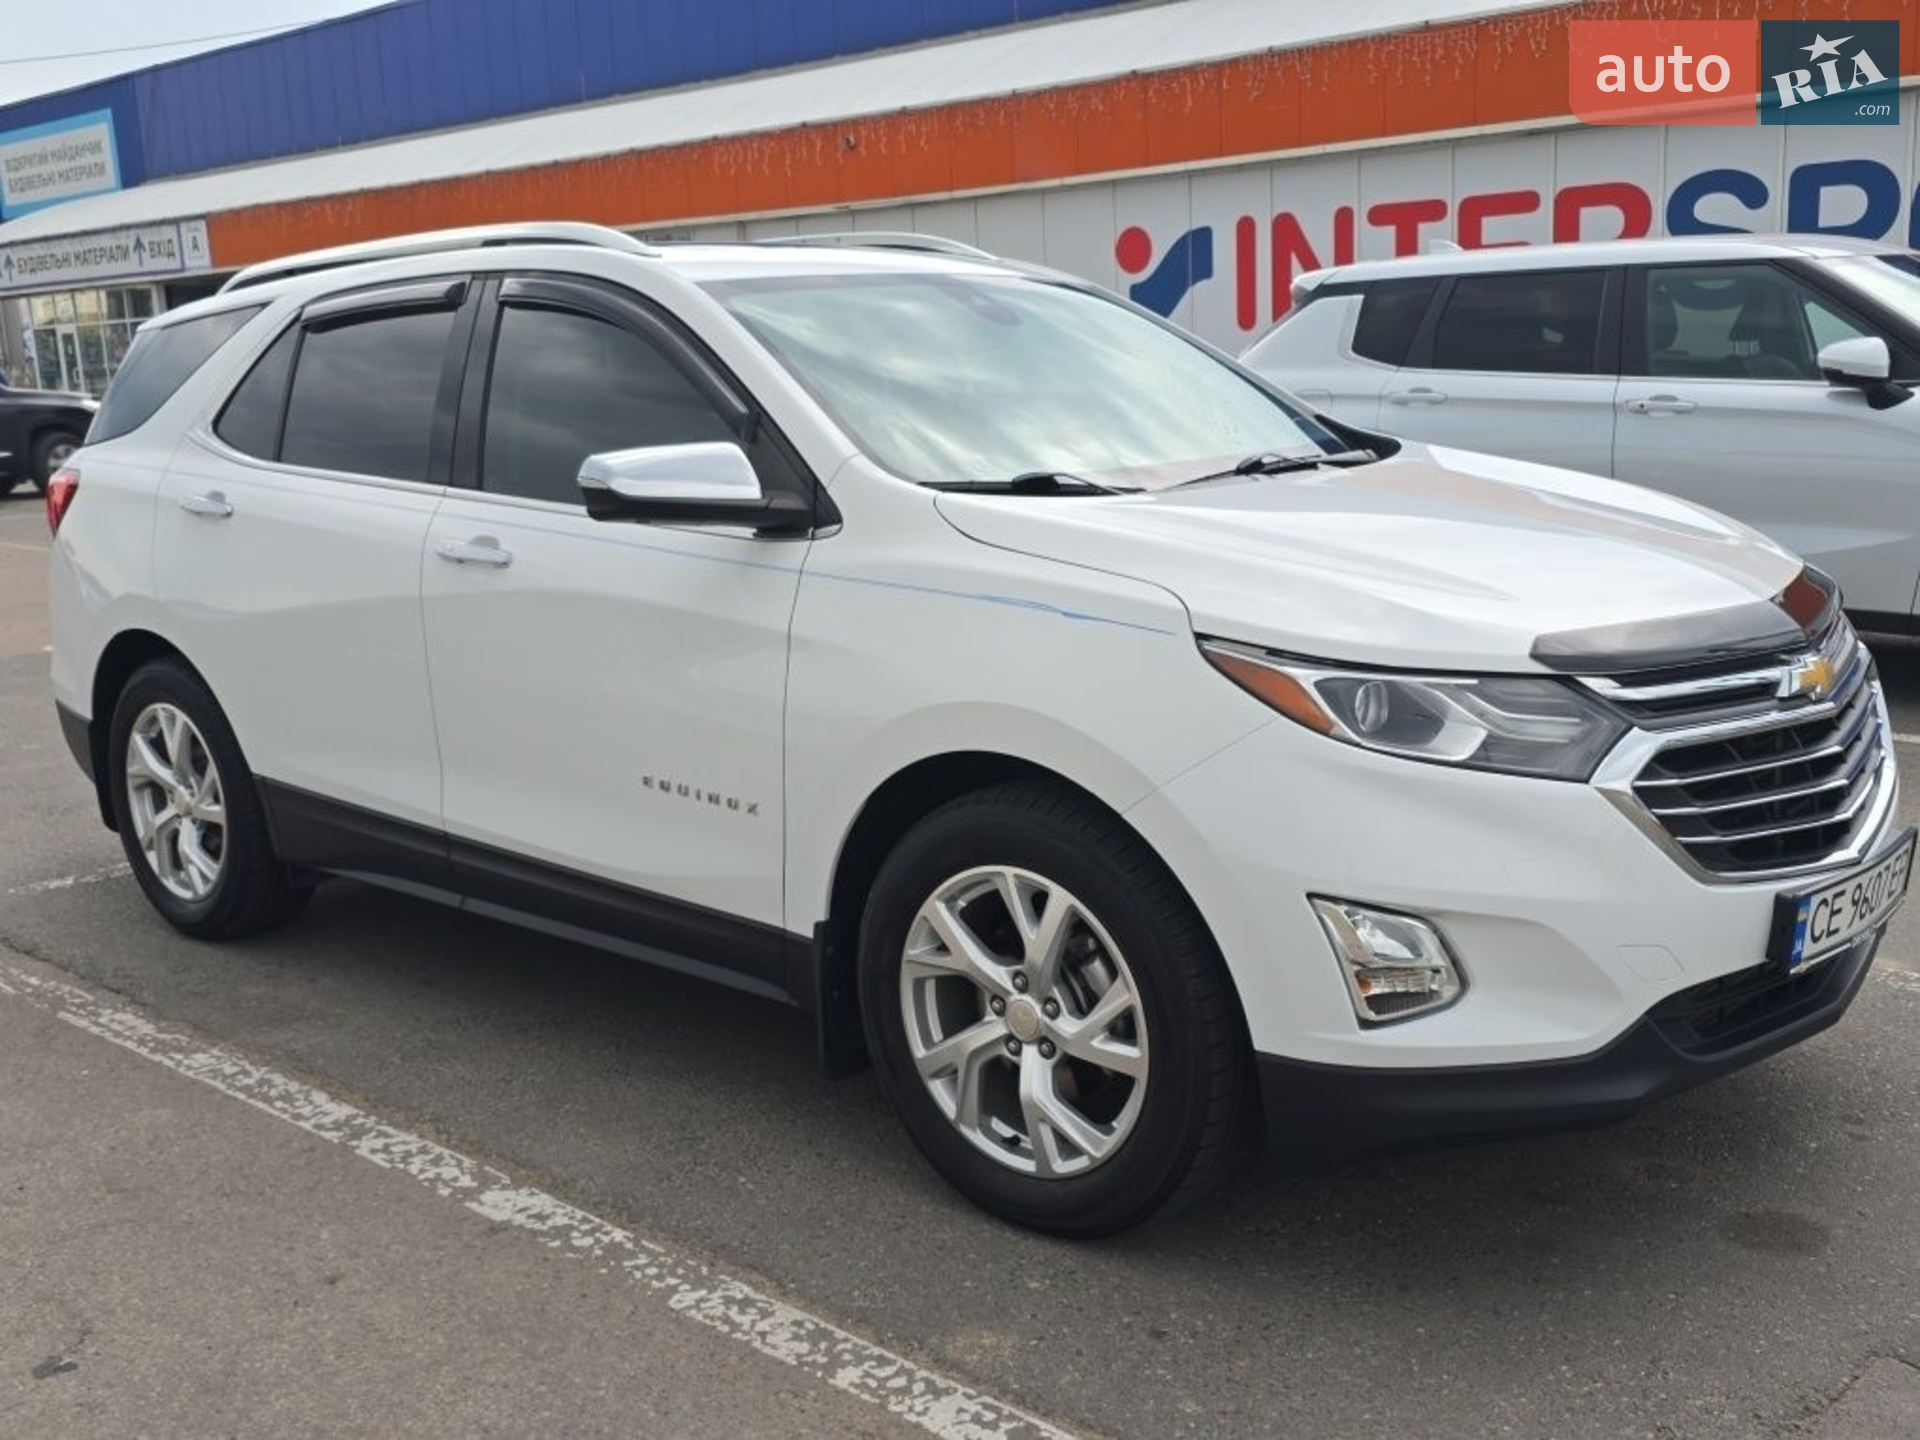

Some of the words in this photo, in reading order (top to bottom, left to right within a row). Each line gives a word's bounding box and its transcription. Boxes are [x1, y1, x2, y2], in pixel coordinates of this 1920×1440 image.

[17, 254, 72, 275] БУДІВЕЛЬНІ
[73, 243, 131, 269] МАТЕРІАЛИ
[149, 238, 176, 260] ВХІД
[642, 775, 758, 815] EQUINOX
